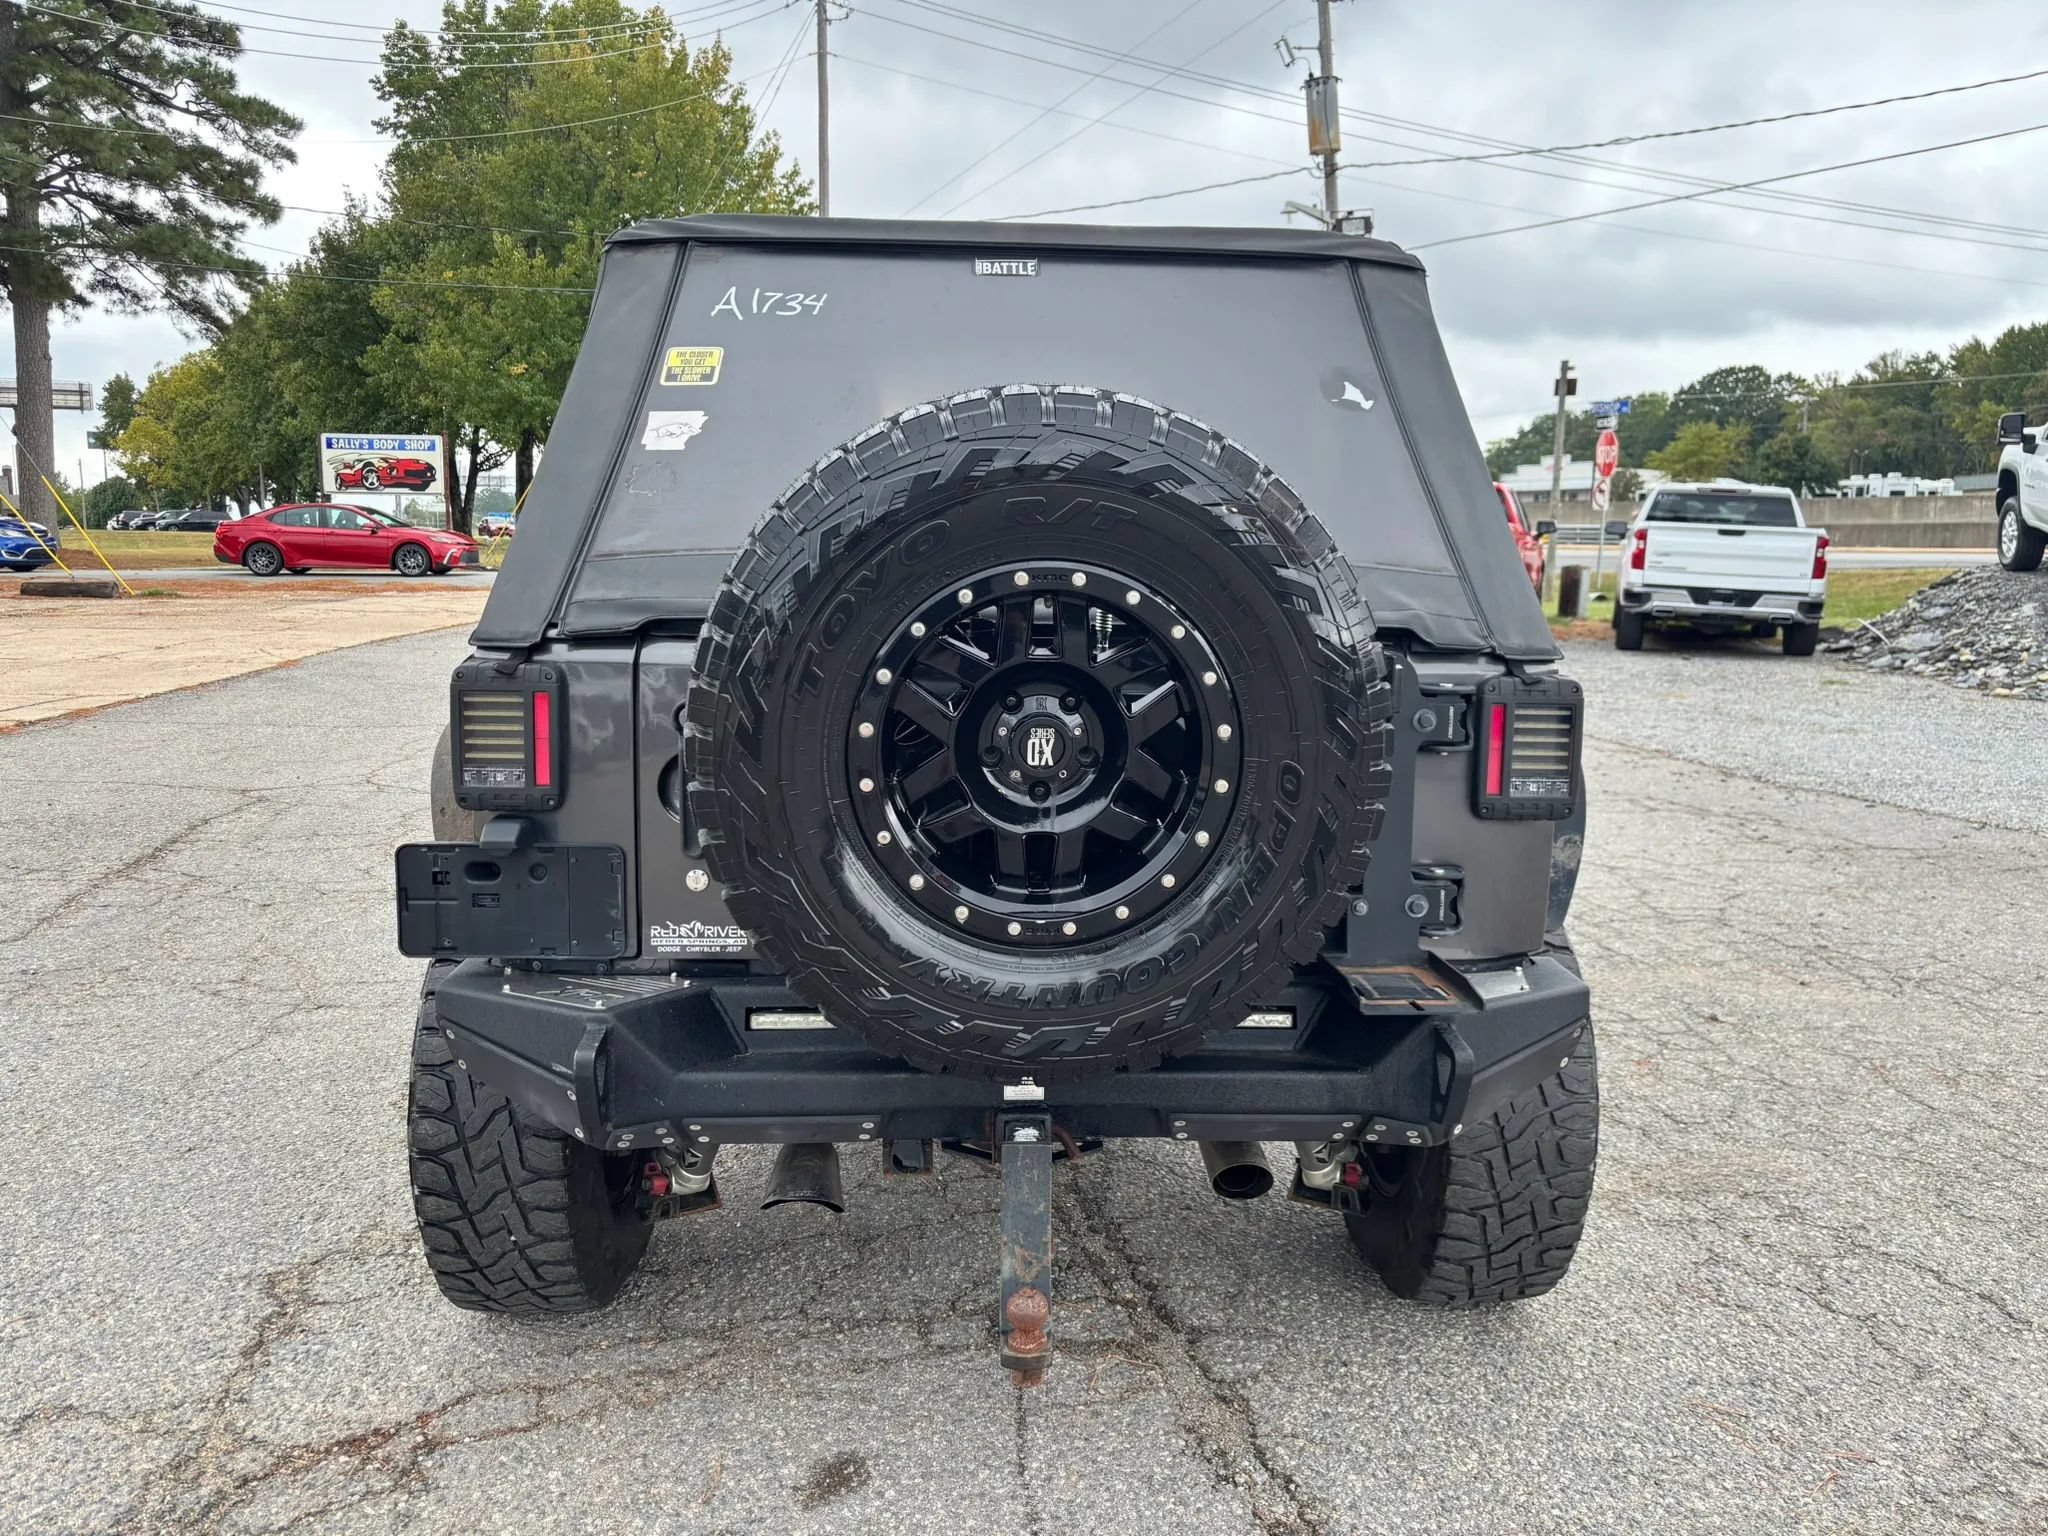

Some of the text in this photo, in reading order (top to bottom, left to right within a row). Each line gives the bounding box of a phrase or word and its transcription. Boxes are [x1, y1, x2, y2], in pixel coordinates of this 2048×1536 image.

[982, 262, 1036, 275] BATTLE
[689, 351, 714, 359] CLOSER
[331, 437, 431, 450] SALLY'S BODY SHOP
[1596, 445, 1617, 464] STOP
[792, 519, 951, 702] TOYO
[1030, 727, 1055, 739] SERIES
[1027, 738, 1055, 766] XD
[899, 760, 1305, 1010] OPEN COUNTRY
[650, 921, 747, 938] RED RIVER
